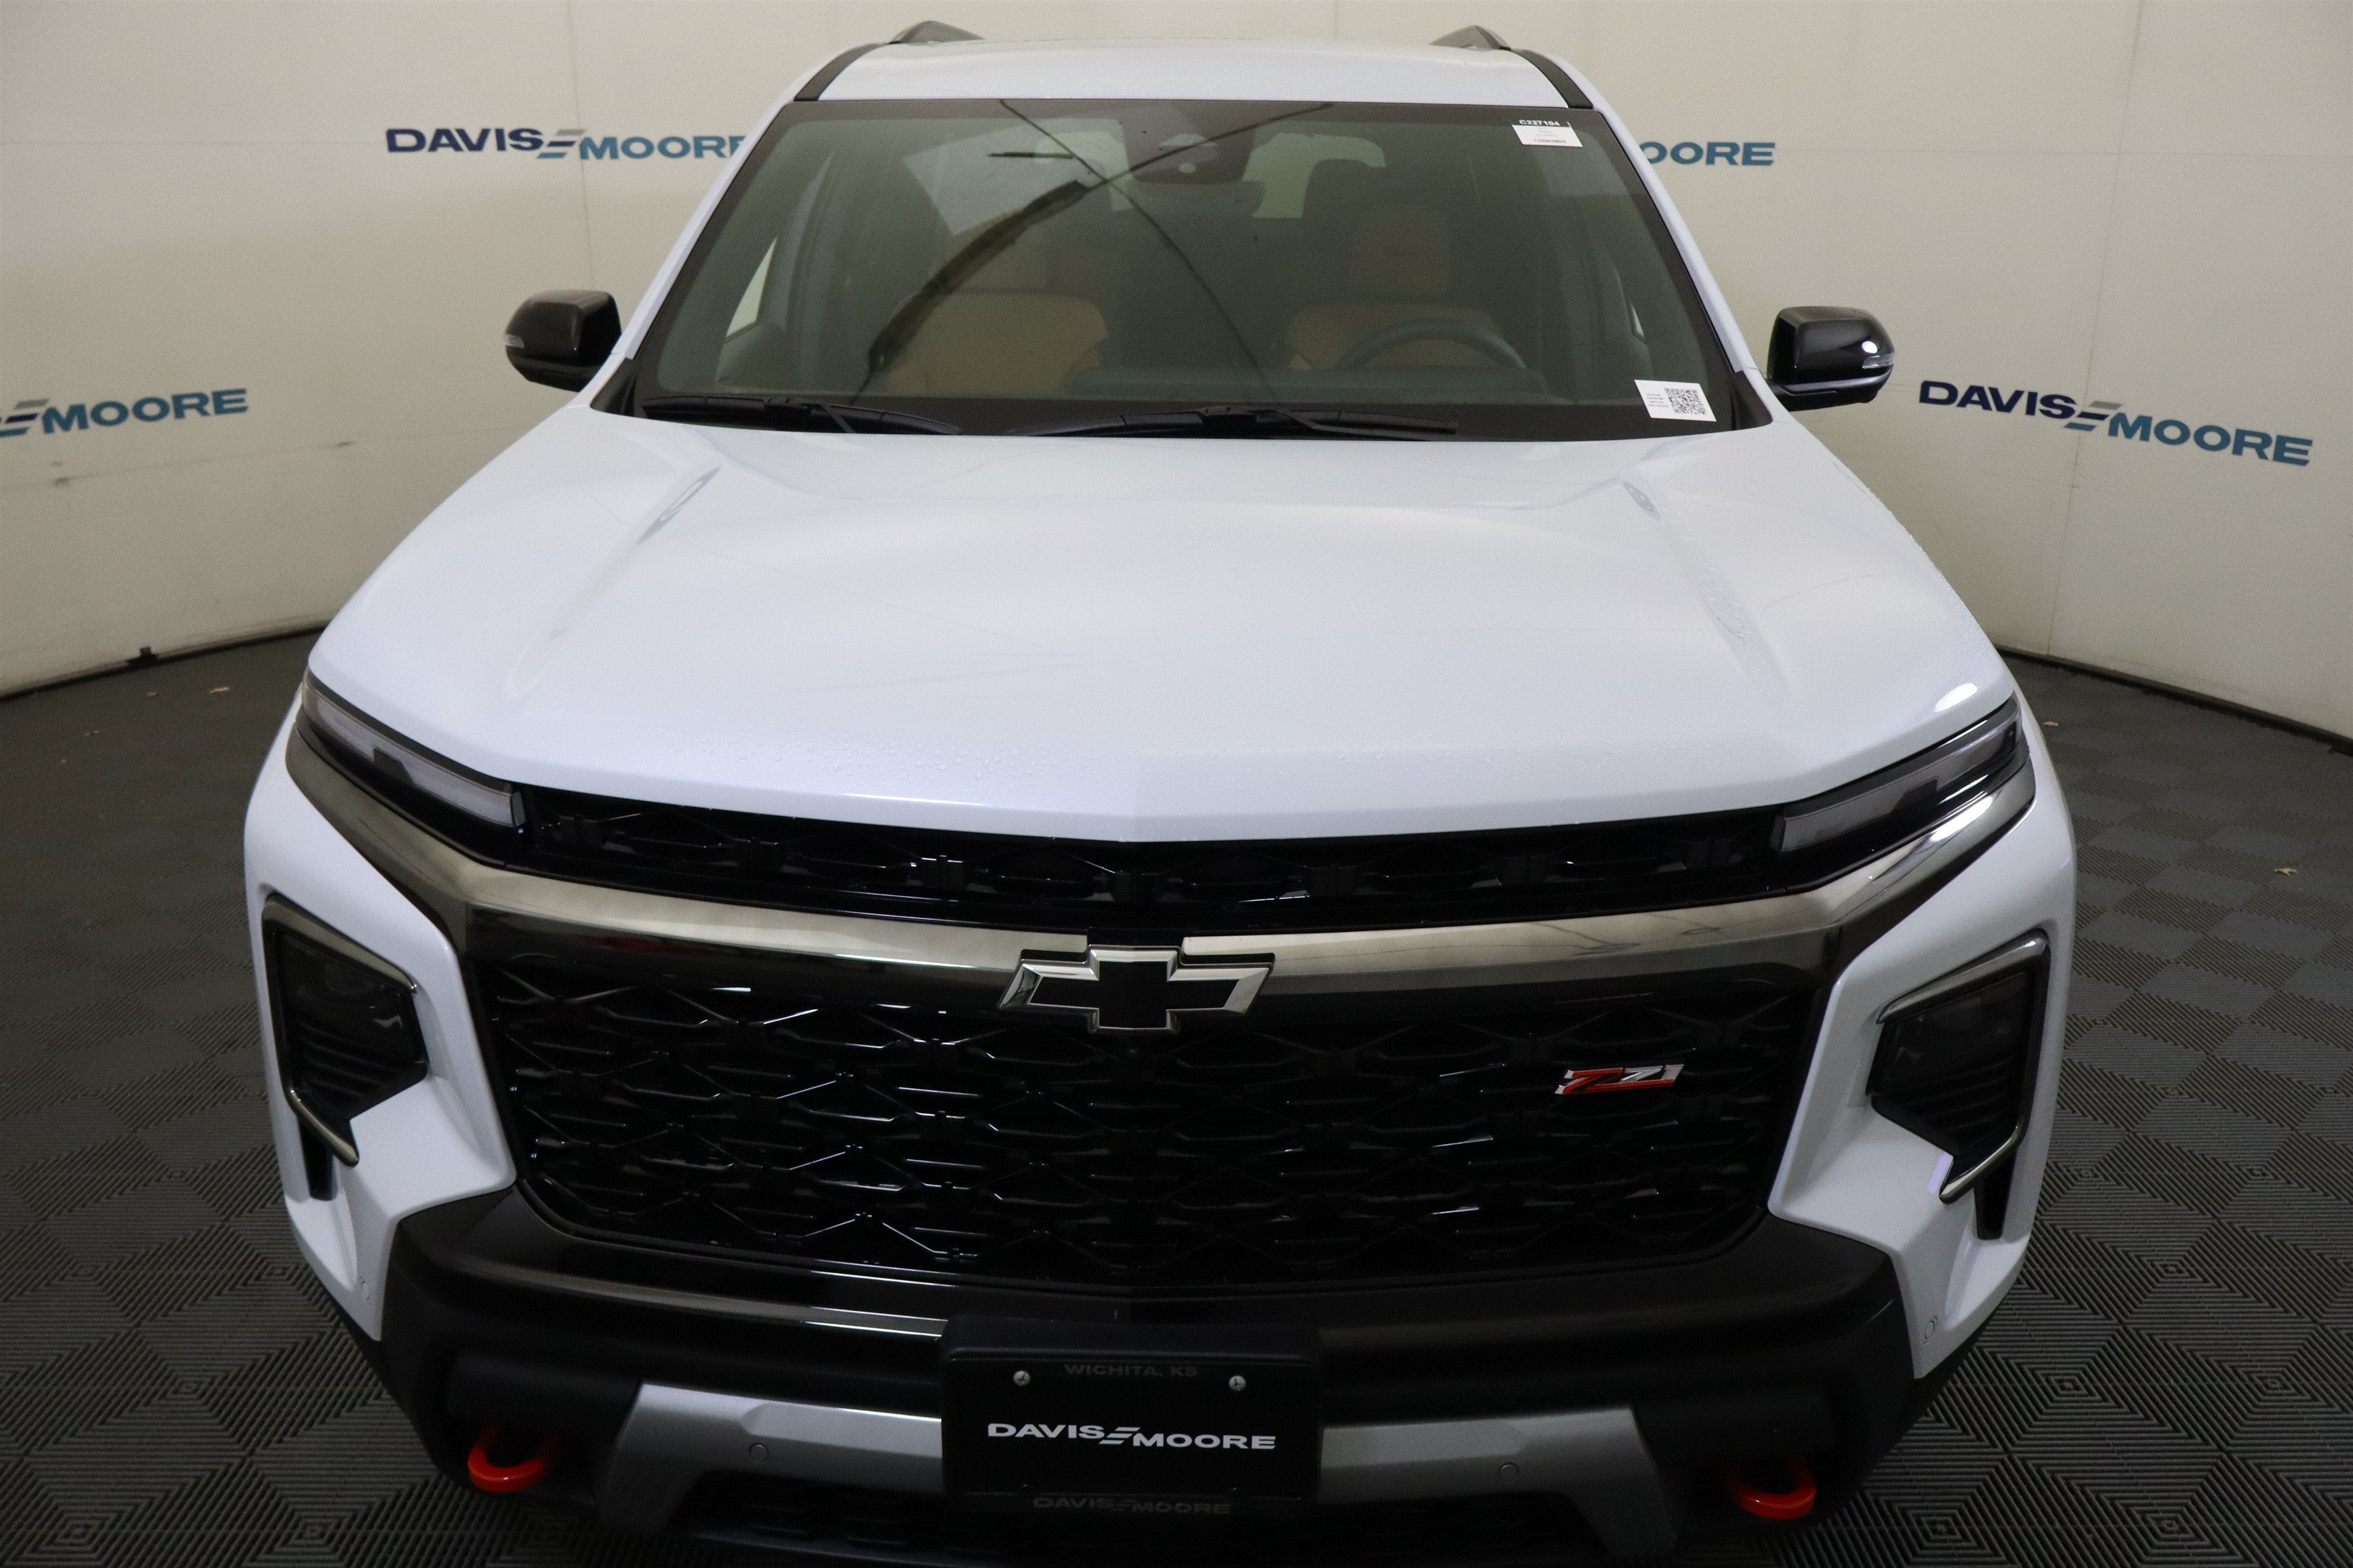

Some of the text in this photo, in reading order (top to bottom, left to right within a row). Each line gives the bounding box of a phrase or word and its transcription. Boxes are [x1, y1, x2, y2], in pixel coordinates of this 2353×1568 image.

[387, 129, 543, 153] DAVIS
[1640, 141, 1776, 165] OORE
[42, 388, 249, 435] MOORE
[1919, 380, 2313, 467] DAVIS MOORE
[1171, 1366, 1199, 1377] KS
[988, 1423, 1276, 1450] DAVIS MOORE
